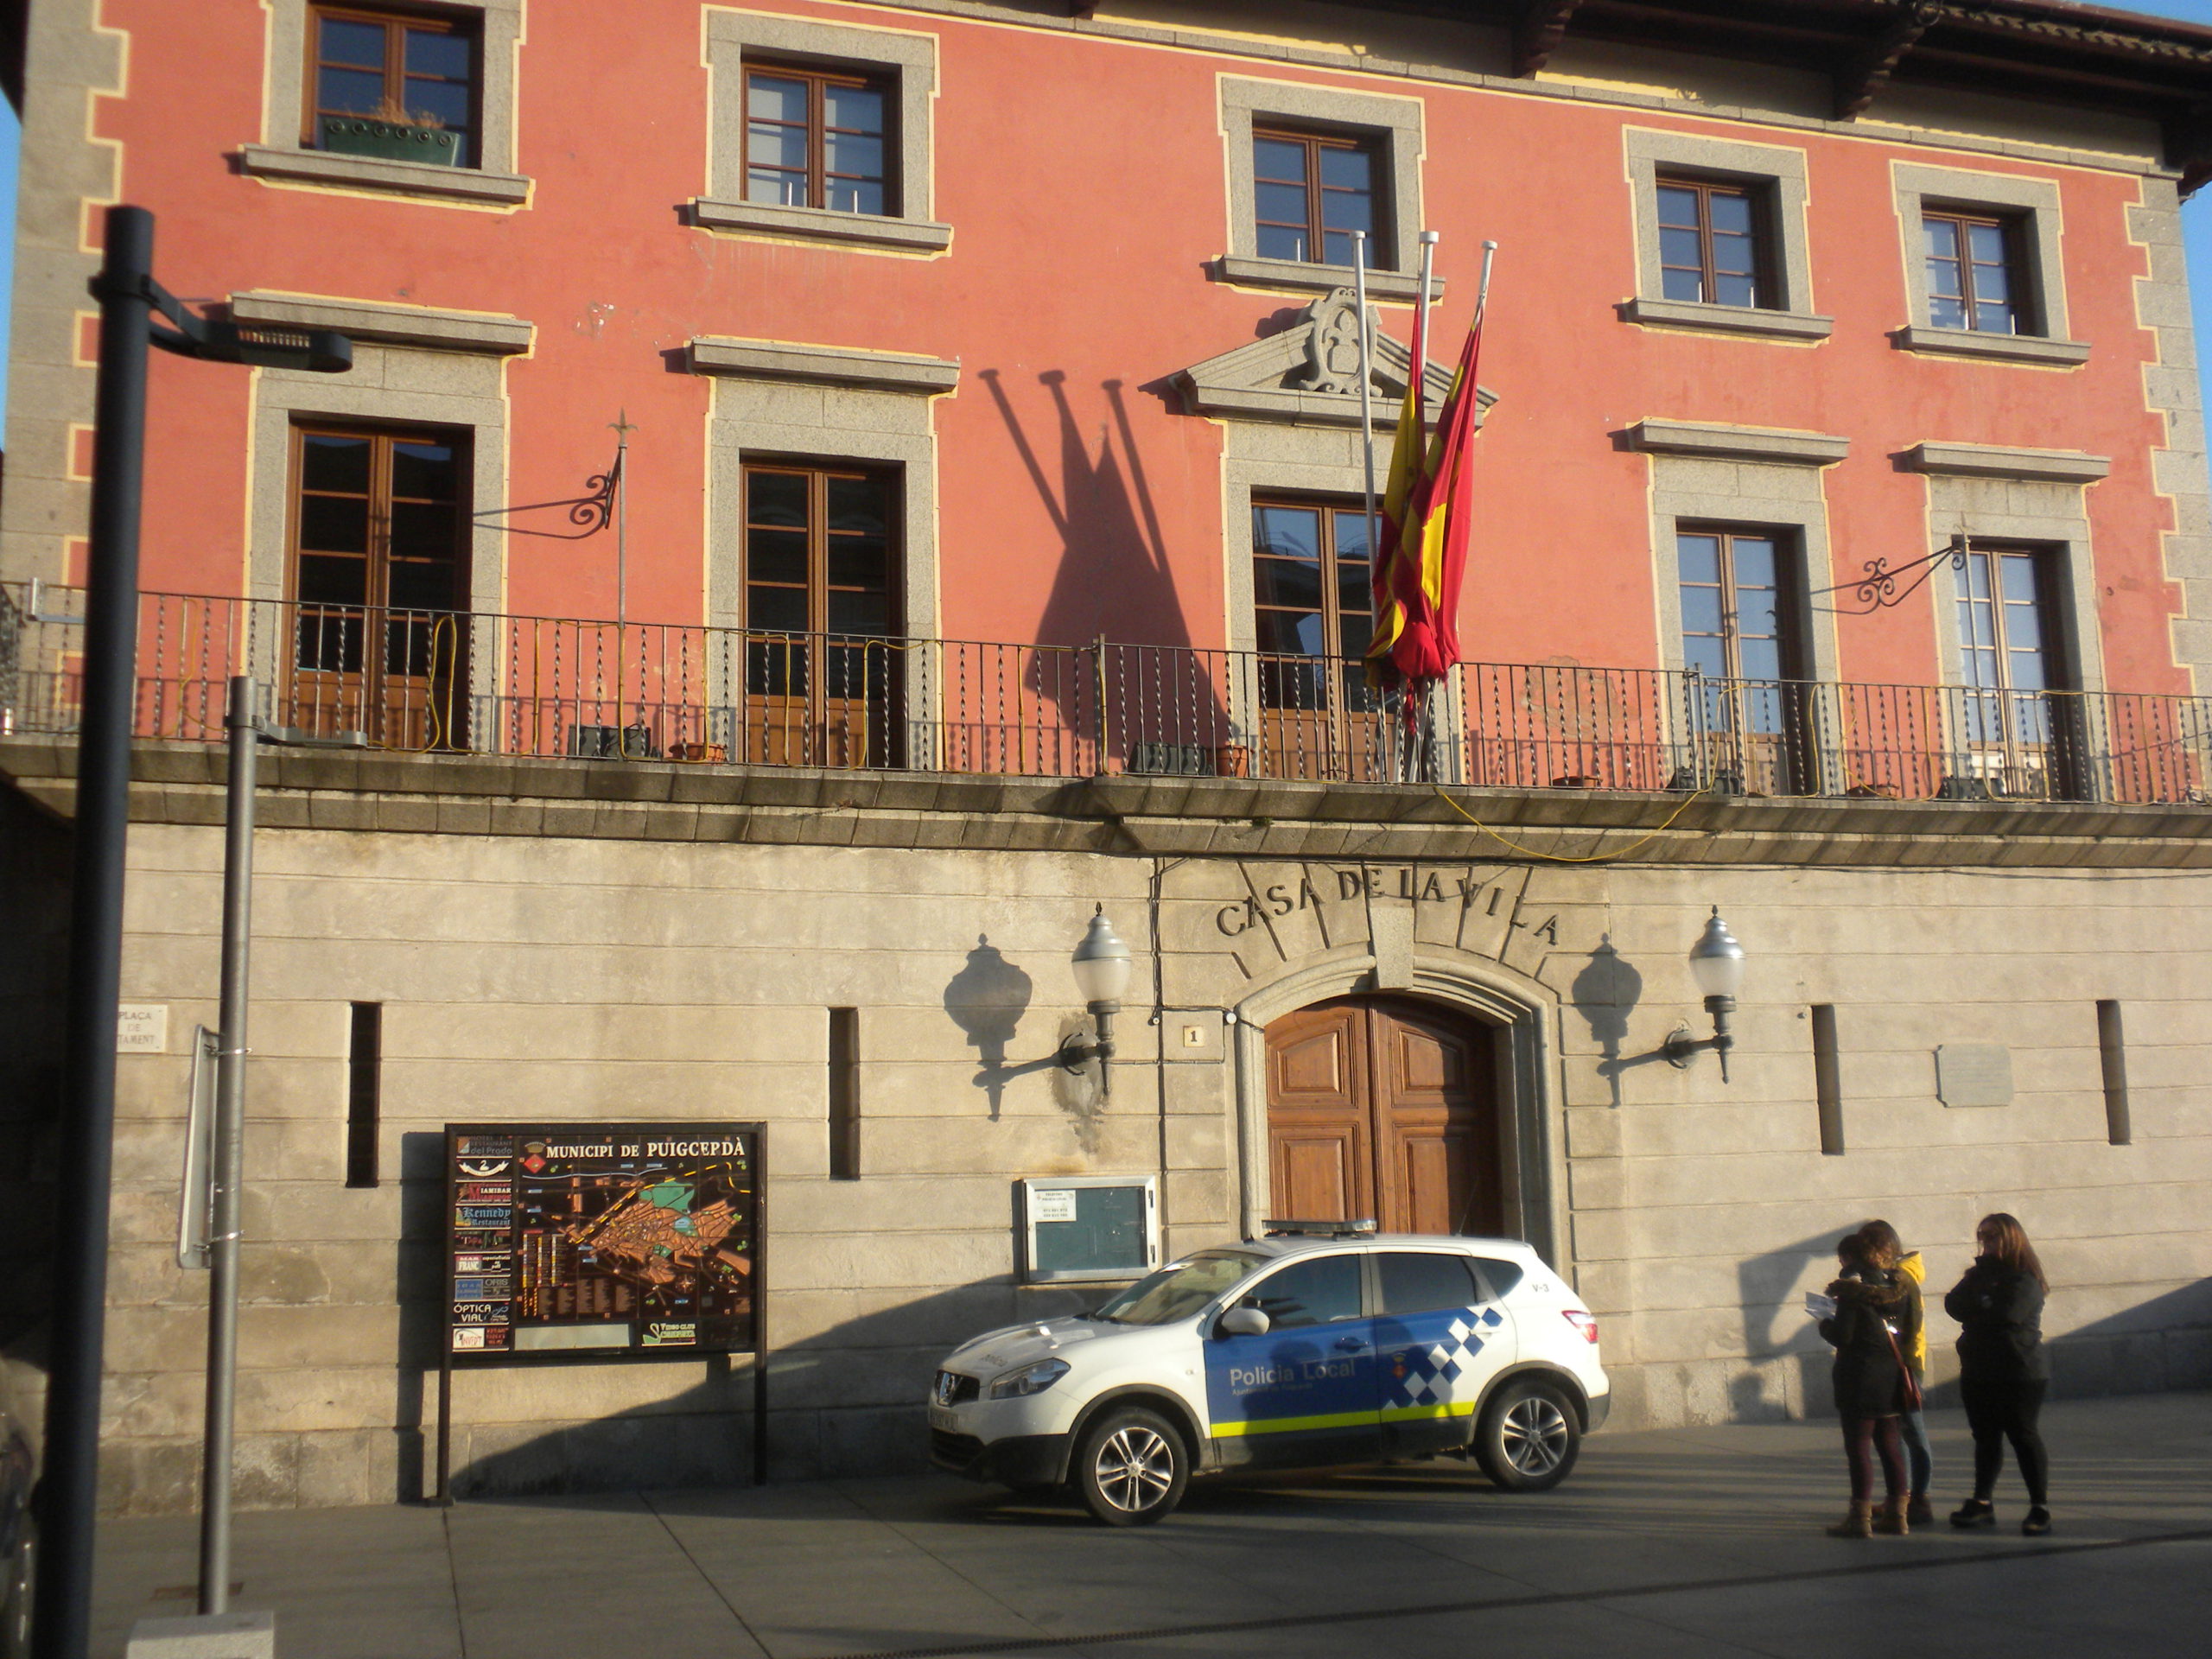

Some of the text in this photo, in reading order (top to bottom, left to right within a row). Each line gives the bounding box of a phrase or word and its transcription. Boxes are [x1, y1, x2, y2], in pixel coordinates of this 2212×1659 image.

[1216, 869, 1559, 946] CASA DE LA VILA
[118, 1034, 155, 1045] TAMENT
[1190, 1030, 1198, 1042] 1
[545, 1144, 613, 1159] MUNICIPI
[620, 1145, 639, 1158] DE
[463, 1207, 512, 1219] Kennedy
[458, 1261, 480, 1271] FRANC
[485, 1278, 509, 1287] ORIS
[1532, 1284, 1549, 1293] V-3
[453, 1303, 492, 1313] ÓPTICA
[461, 1313, 484, 1322] VIAL
[1230, 1357, 1356, 1388] Policia Local
